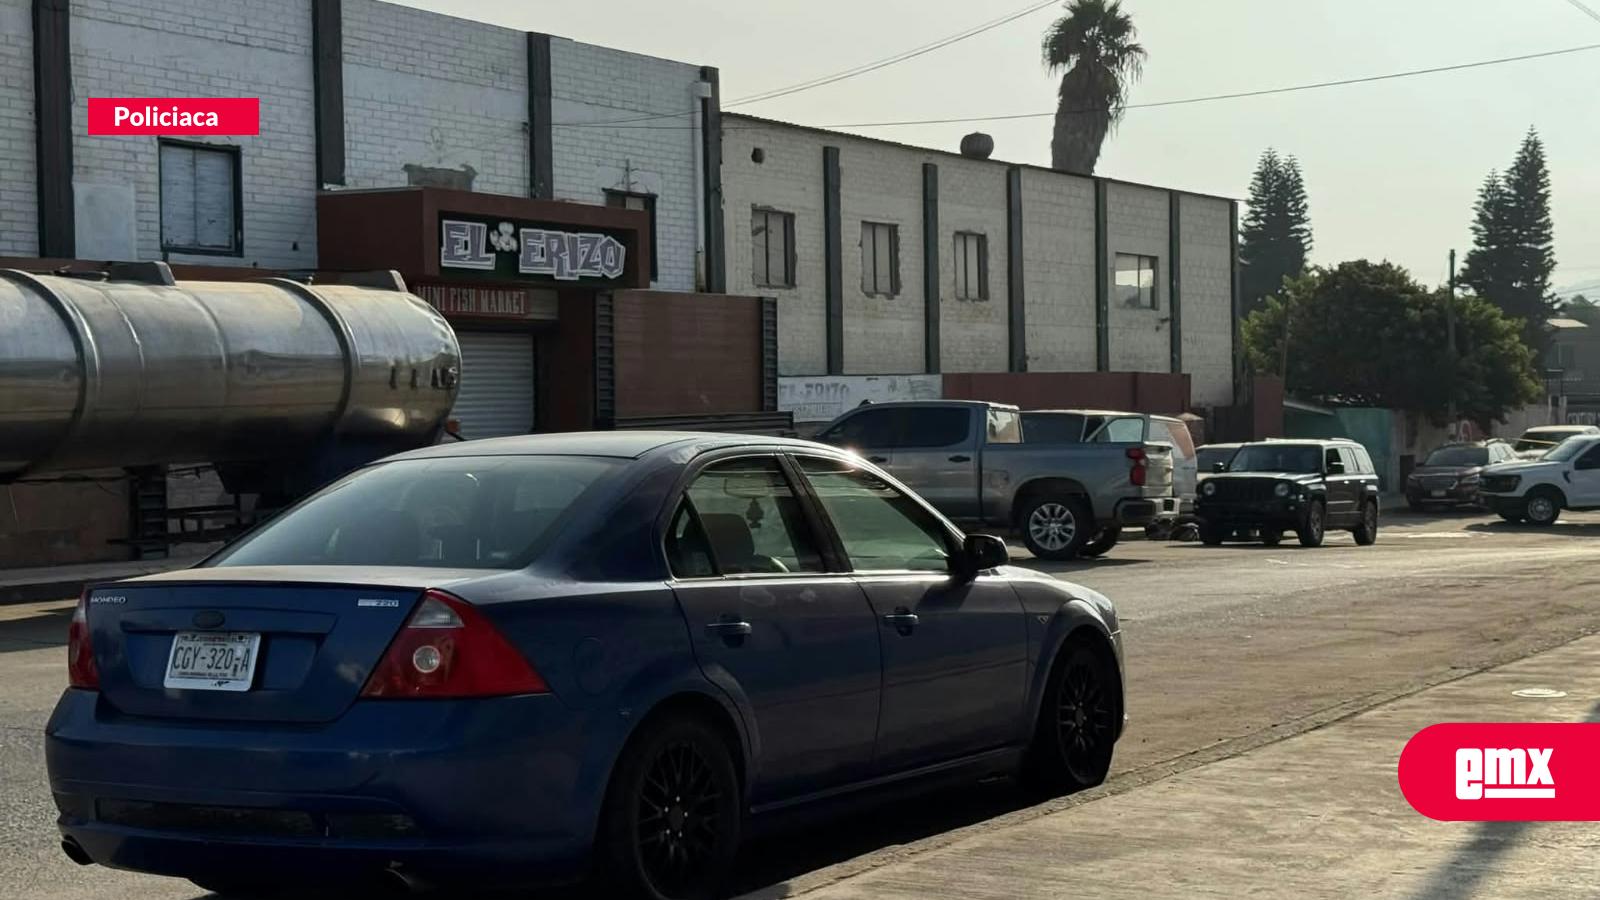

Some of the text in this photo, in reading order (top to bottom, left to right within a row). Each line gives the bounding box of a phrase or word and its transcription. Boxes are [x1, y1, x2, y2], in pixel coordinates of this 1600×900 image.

[441, 219, 626, 280] EL ERIZO
[449, 287, 477, 312] FISH
[480, 289, 526, 314] MARKET
[173, 645, 251, 673] CGY-320-A
